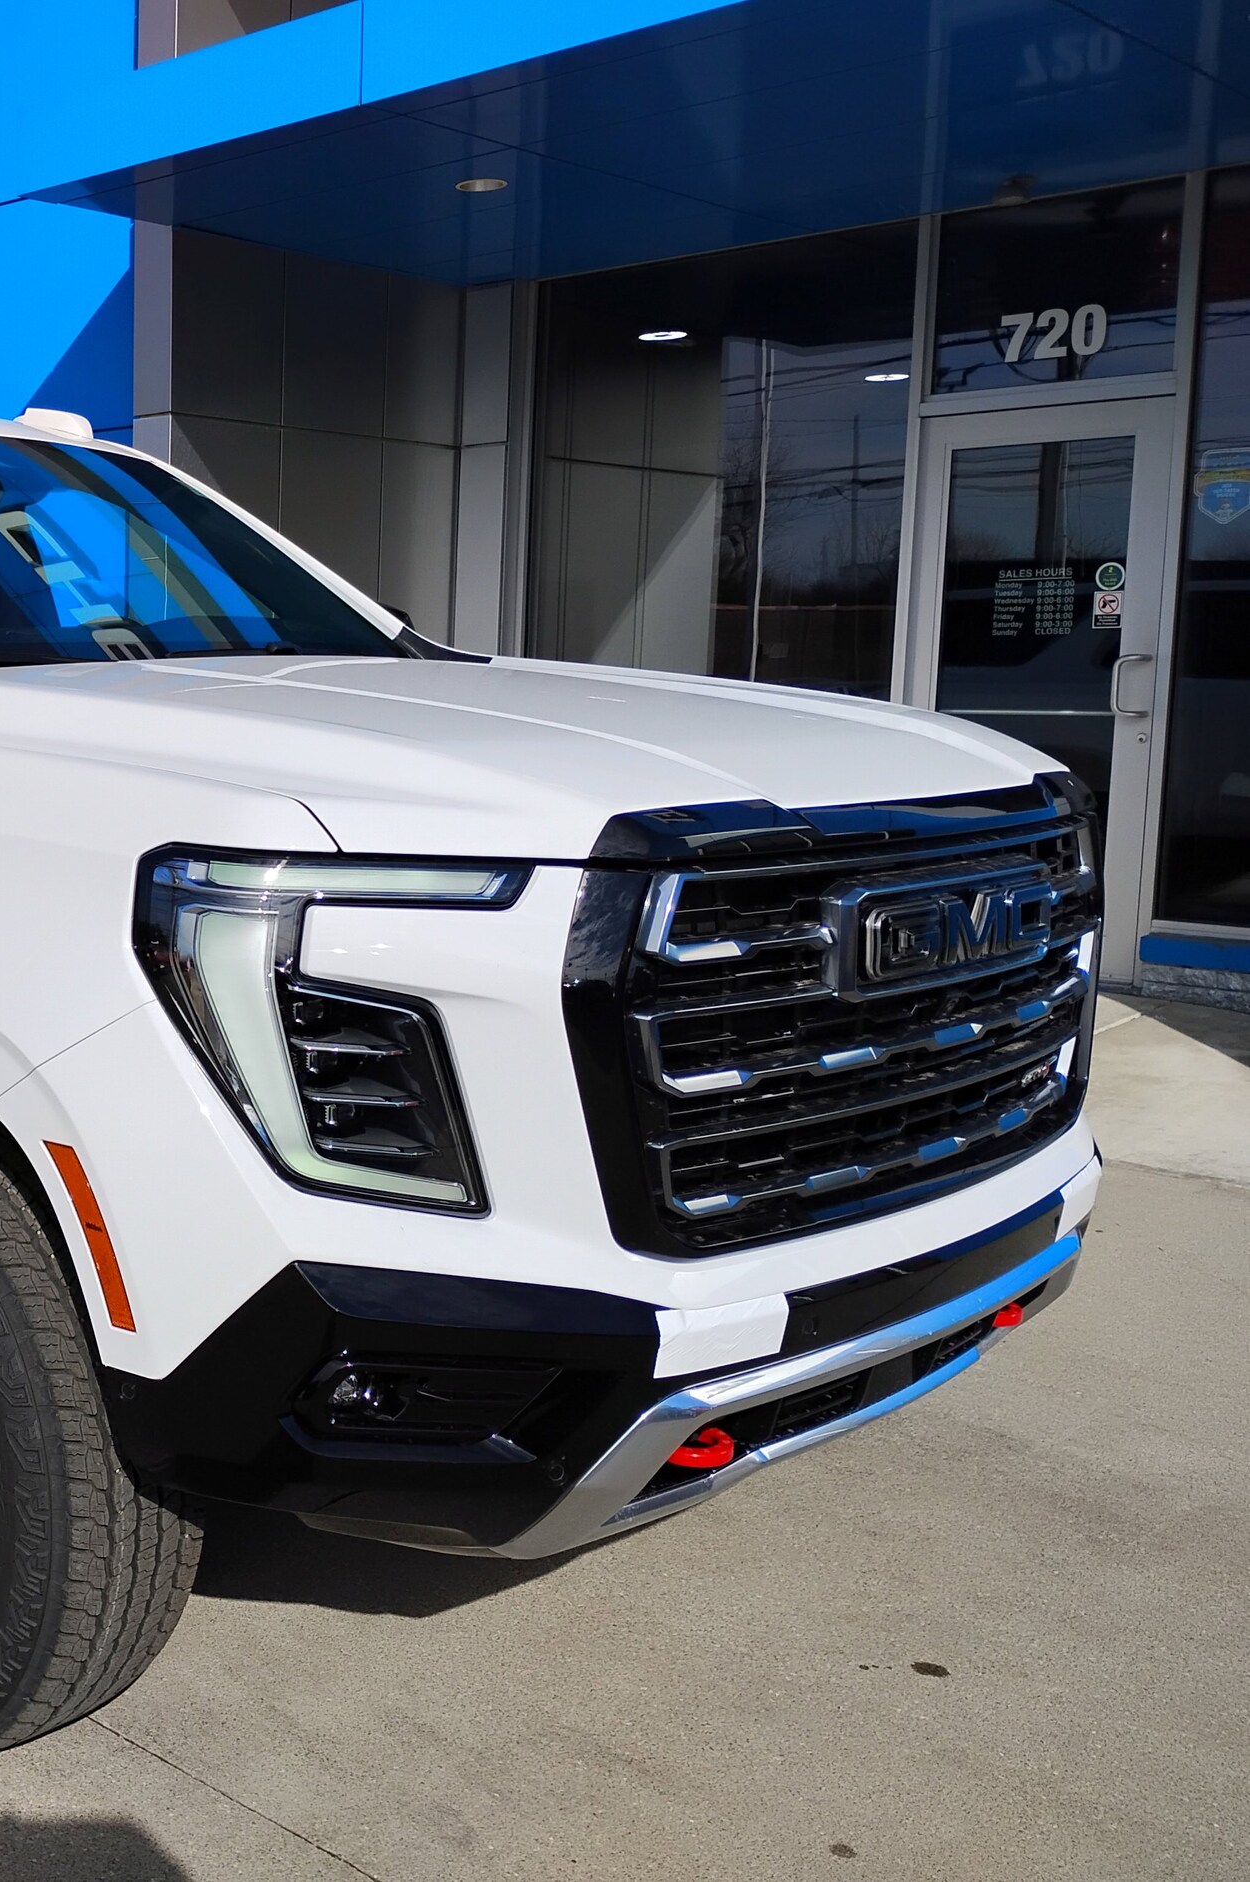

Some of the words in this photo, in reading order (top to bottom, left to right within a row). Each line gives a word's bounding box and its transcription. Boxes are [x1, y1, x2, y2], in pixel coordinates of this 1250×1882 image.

[1001, 304, 1107, 363] 720
[998, 569, 1033, 579] SALES
[1035, 567, 1073, 577] HOURS
[994, 582, 1023, 590] Monday
[993, 605, 1026, 613] Thursday
[993, 613, 1015, 621] Friday
[992, 629, 1018, 637] Sunday
[1034, 627, 1071, 635] CLOSED
[864, 880, 1052, 981] GMC
